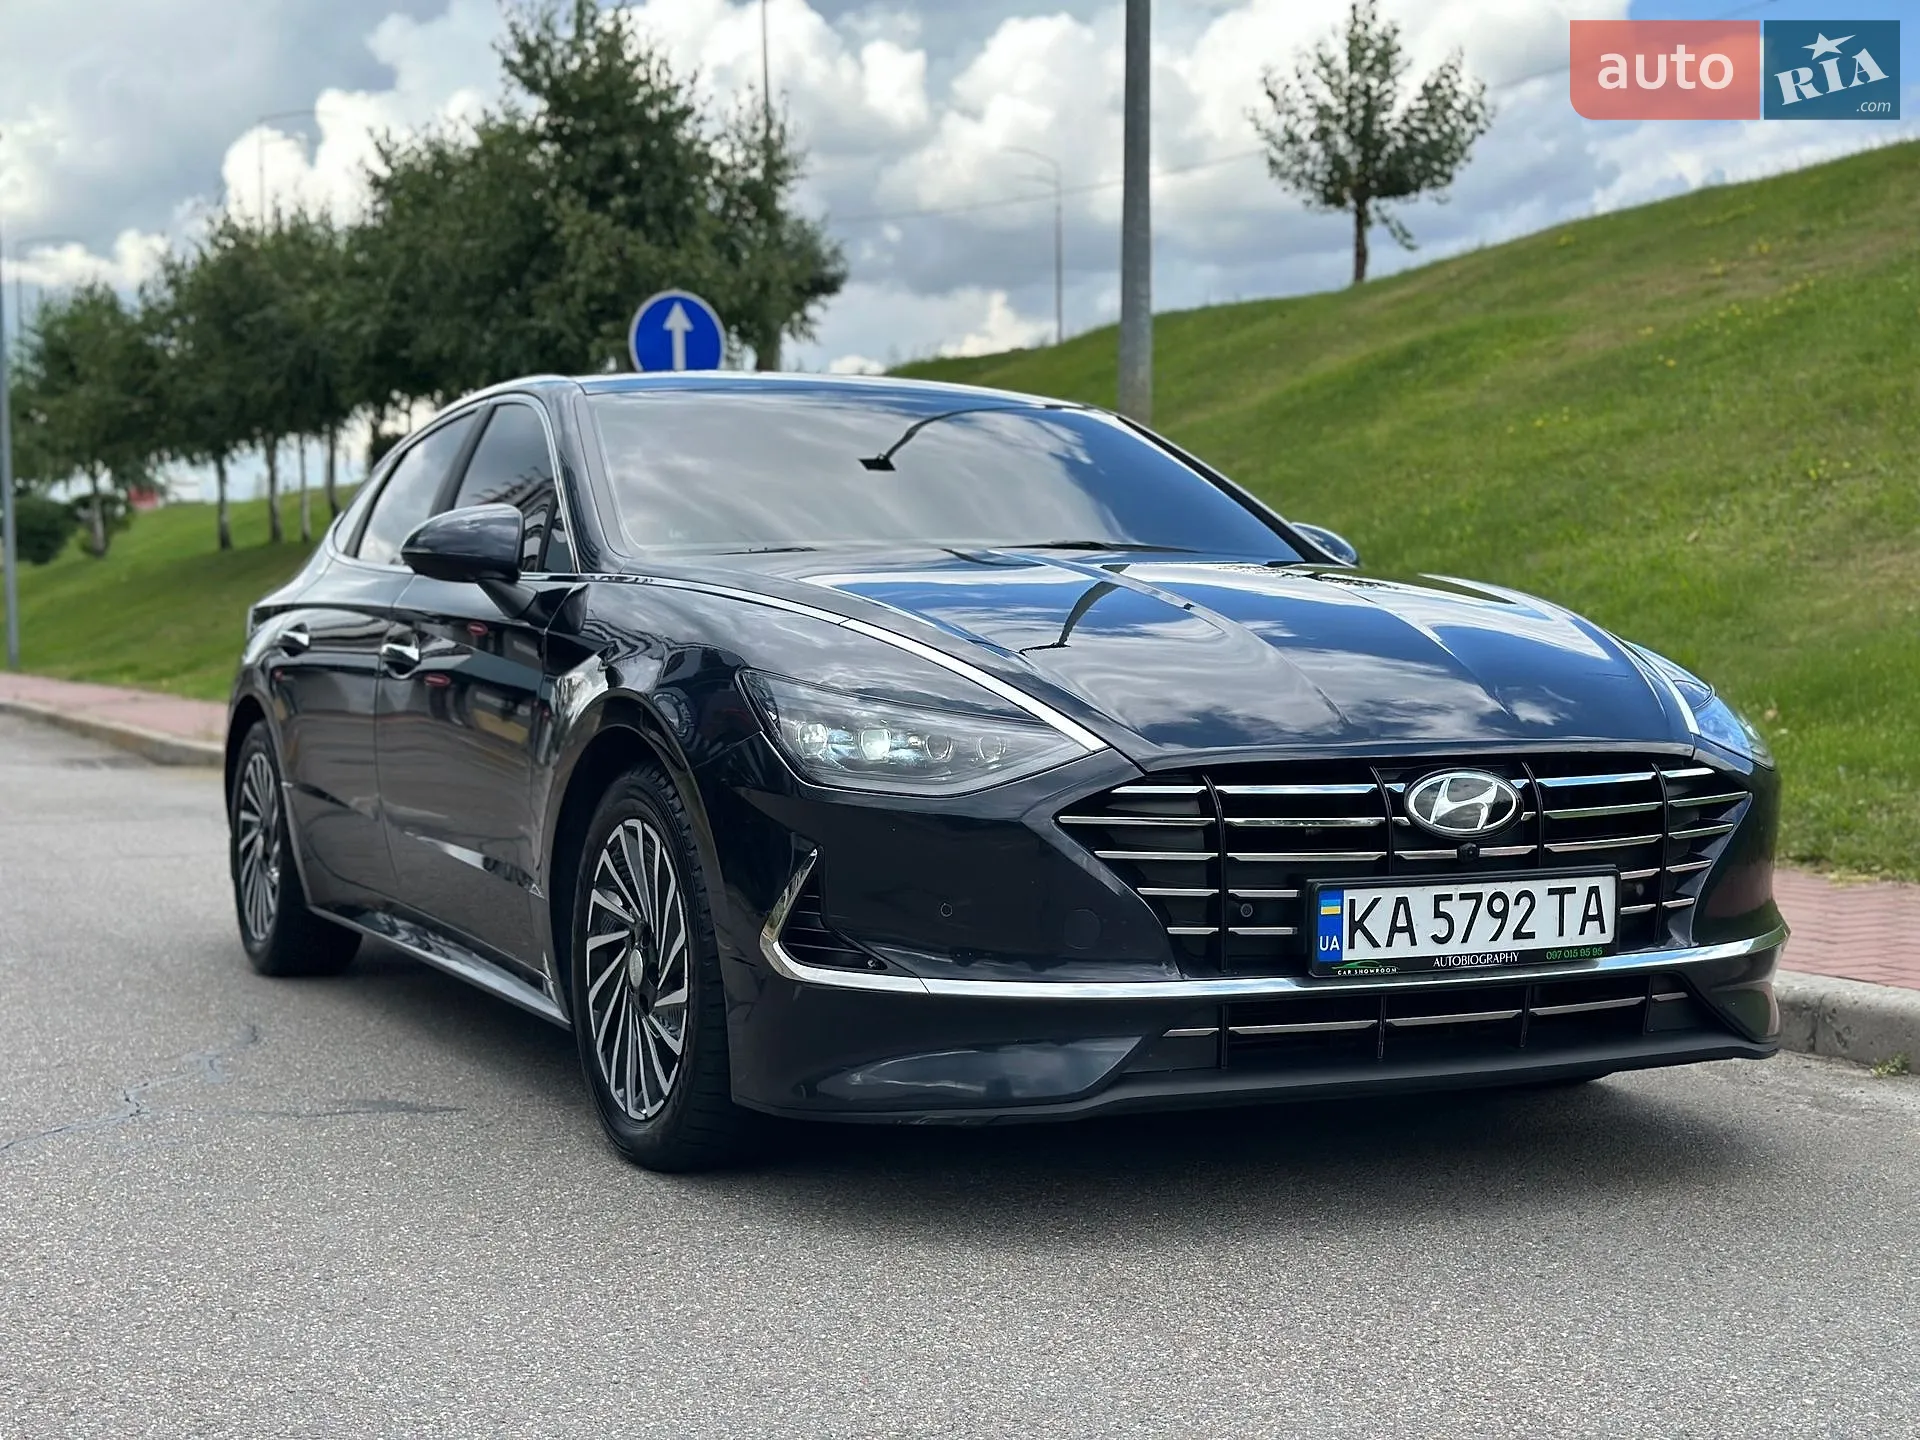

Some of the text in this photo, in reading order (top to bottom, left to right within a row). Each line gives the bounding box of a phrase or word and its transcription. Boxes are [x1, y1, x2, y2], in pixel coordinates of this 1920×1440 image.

[1348, 885, 1606, 949] KA 5792 TA
[1320, 935, 1340, 951] UA
[1433, 951, 1519, 967] AUTOBIOGRAPHY
[1354, 967, 1397, 975] SHOWROOM
